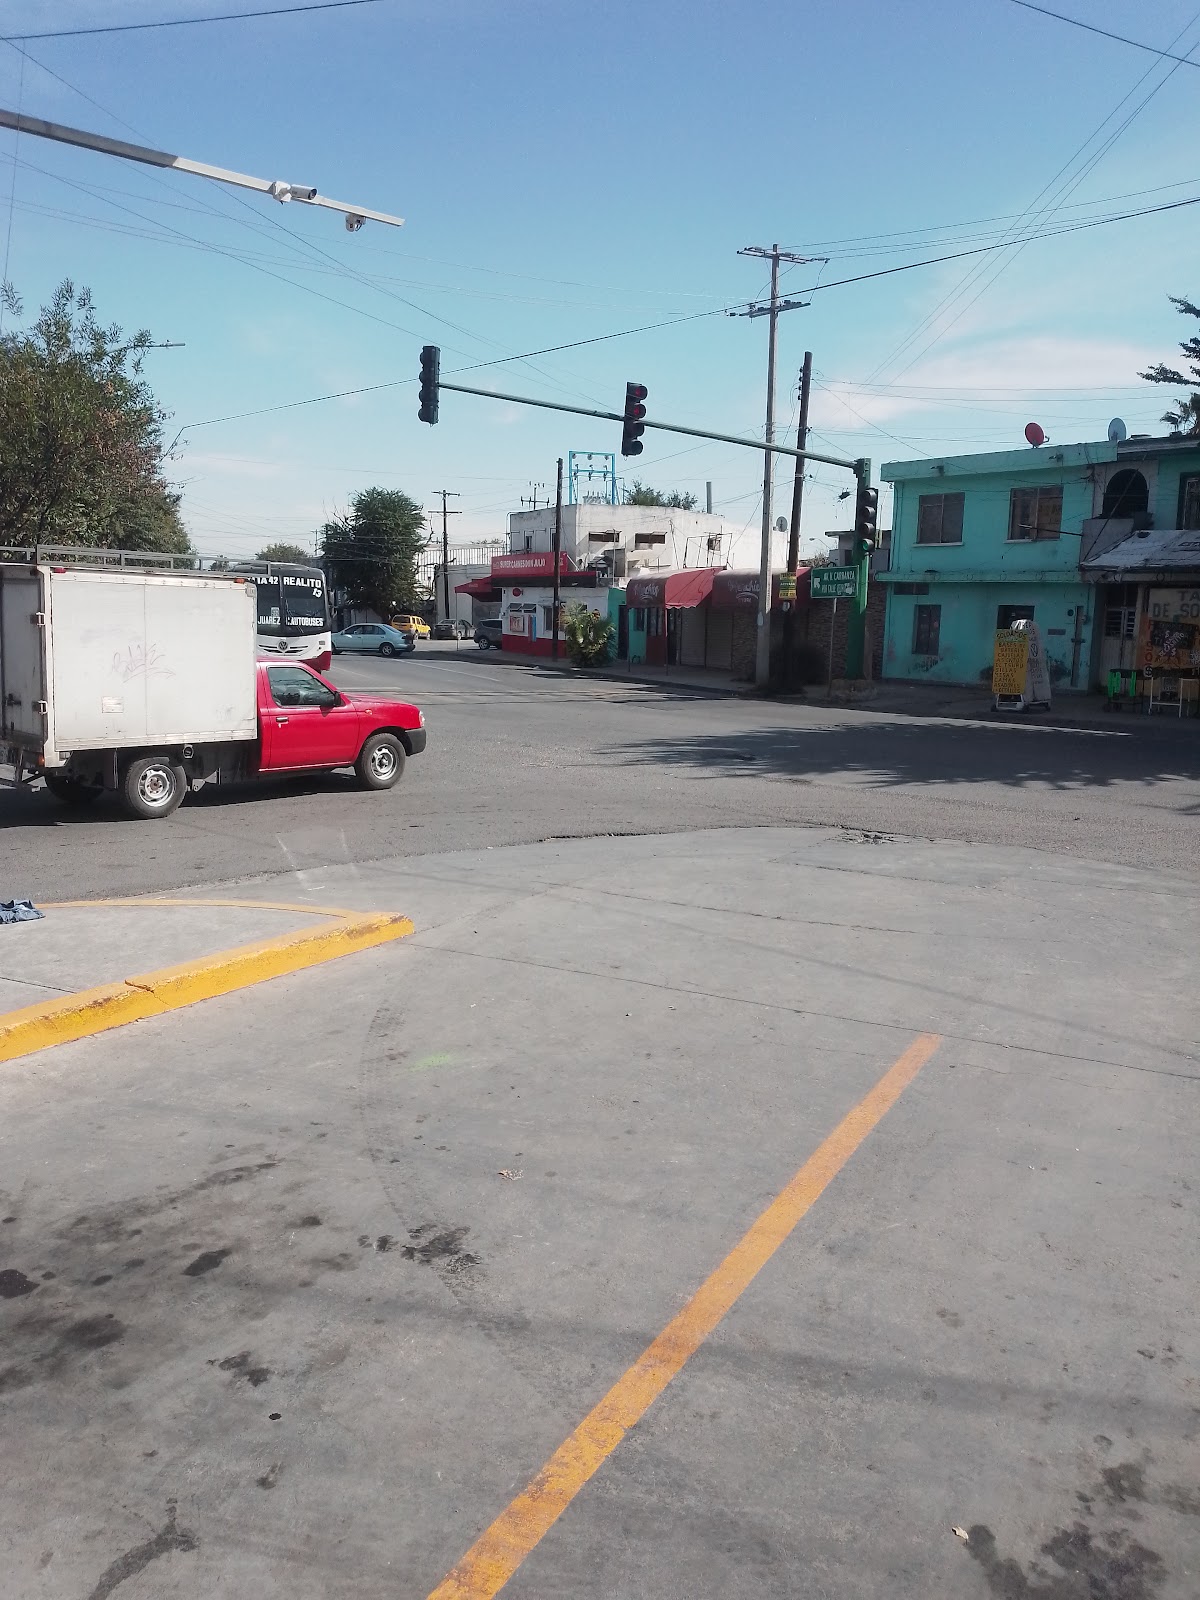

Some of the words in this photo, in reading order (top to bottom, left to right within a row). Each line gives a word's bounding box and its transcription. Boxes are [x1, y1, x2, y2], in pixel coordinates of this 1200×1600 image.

[268, 576, 278, 584] 42
[833, 570, 855, 581] CARRANZA
[283, 577, 321, 588] REALITO
[313, 588, 322, 598] 13
[1153, 603, 1169, 617] DE
[258, 616, 280, 625] JUAREZ
